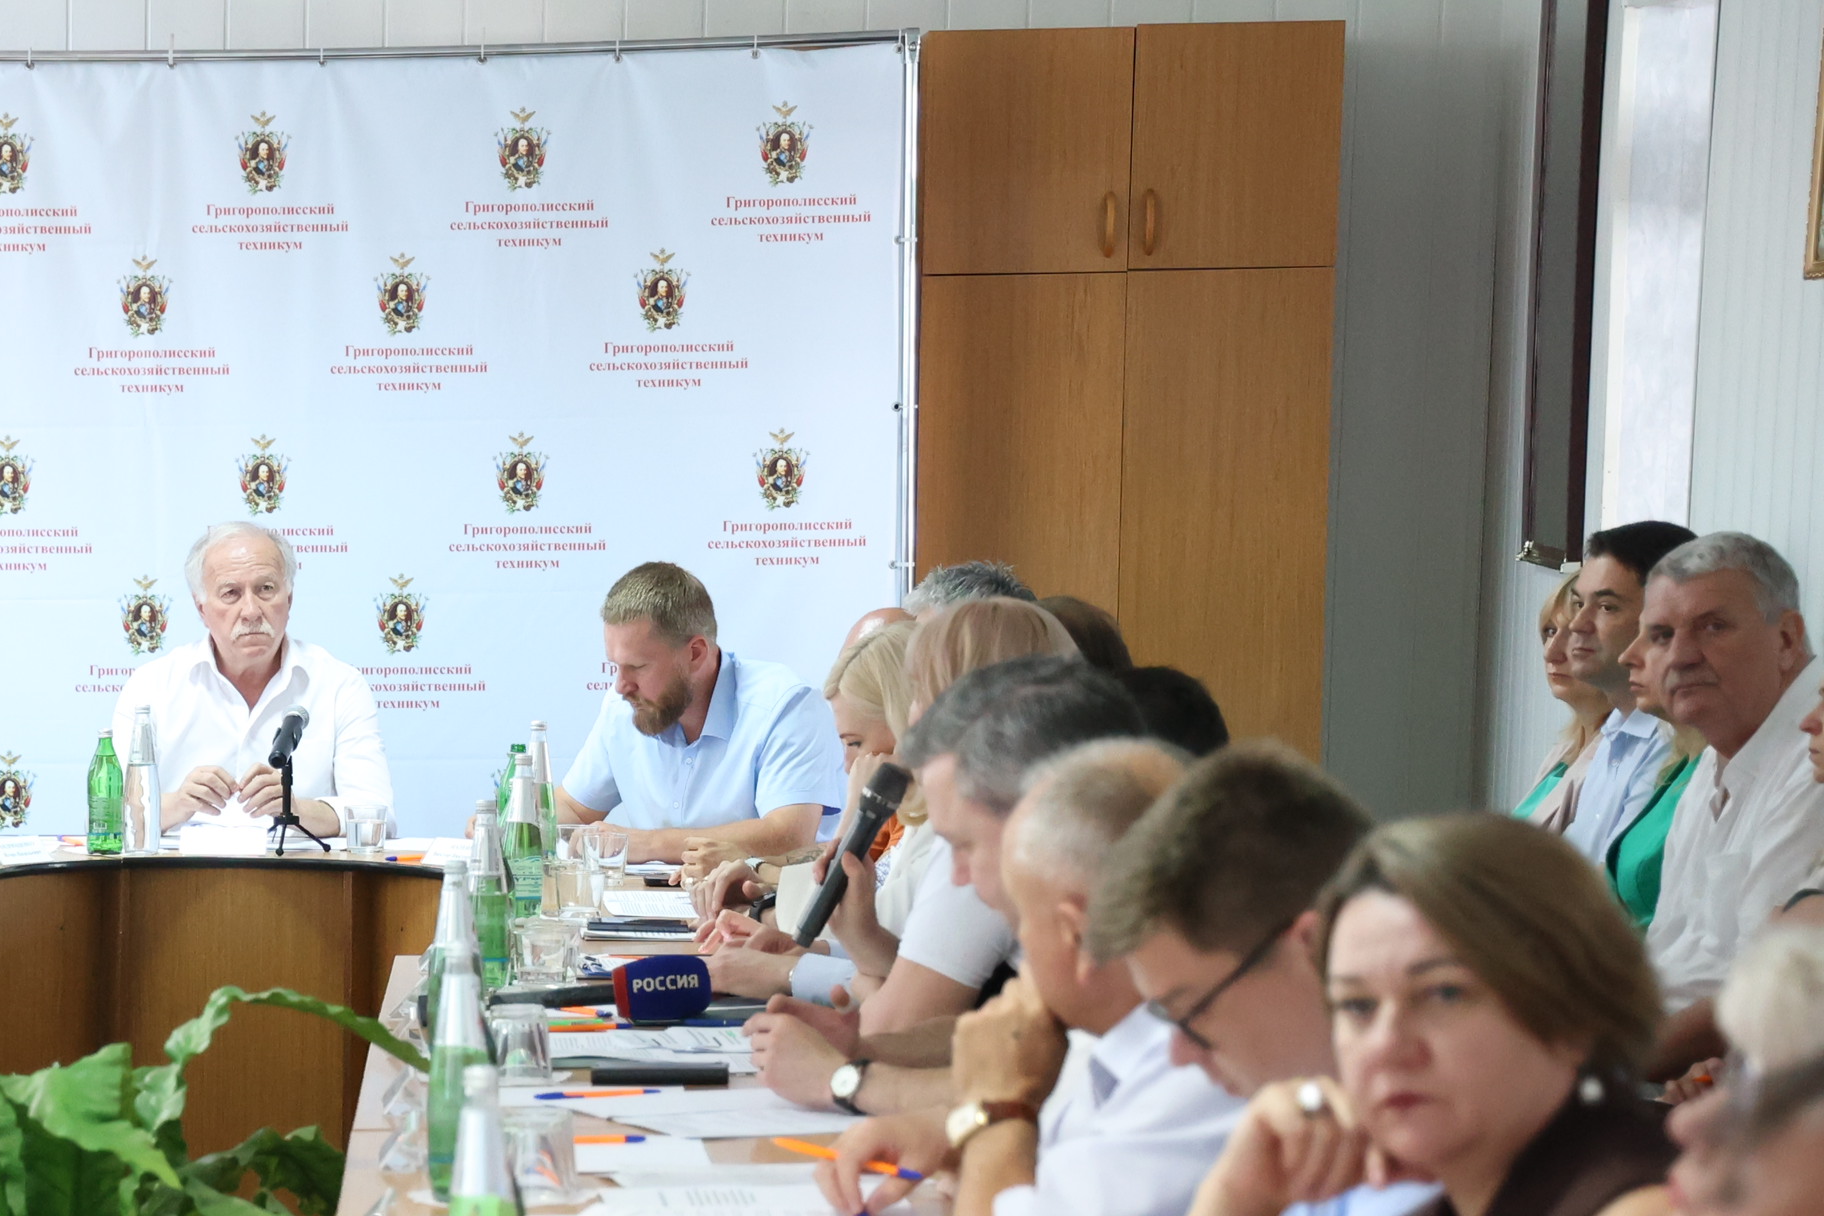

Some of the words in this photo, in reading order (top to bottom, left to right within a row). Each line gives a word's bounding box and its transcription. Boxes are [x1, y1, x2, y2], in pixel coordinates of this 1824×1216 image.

[465, 200, 594, 216] Григорополисский
[727, 194, 856, 211] Григорополисский
[207, 203, 334, 219] Григорополисский
[450, 217, 608, 230] сельскохозяйственный
[711, 211, 871, 226] сельскохозяйственный
[192, 220, 348, 233] сельскохозяйственный
[496, 236, 562, 249] техникум
[758, 231, 824, 244] техникум
[238, 240, 303, 253] техникум
[89, 347, 216, 362] Григорополисский
[346, 345, 474, 360] Григорополисский
[605, 342, 734, 357] Григорополисский
[74, 362, 229, 376] сельскохозяйственный
[330, 361, 487, 374] сельскохозяйственный
[589, 358, 748, 371] сельскохозяйственный
[120, 382, 184, 395] техникум
[377, 379, 442, 393] техникум
[636, 377, 701, 391] техникум
[463, 524, 592, 539] Григорополисский
[723, 519, 852, 535] Григорополисский
[449, 540, 607, 552] сельскохозяйственный
[708, 536, 866, 550] сельскохозяйственный
[496, 558, 560, 571] техникум
[754, 554, 820, 568] техникум
[376, 700, 440, 711] техникум
[632, 974, 699, 993] РОССИЯ
